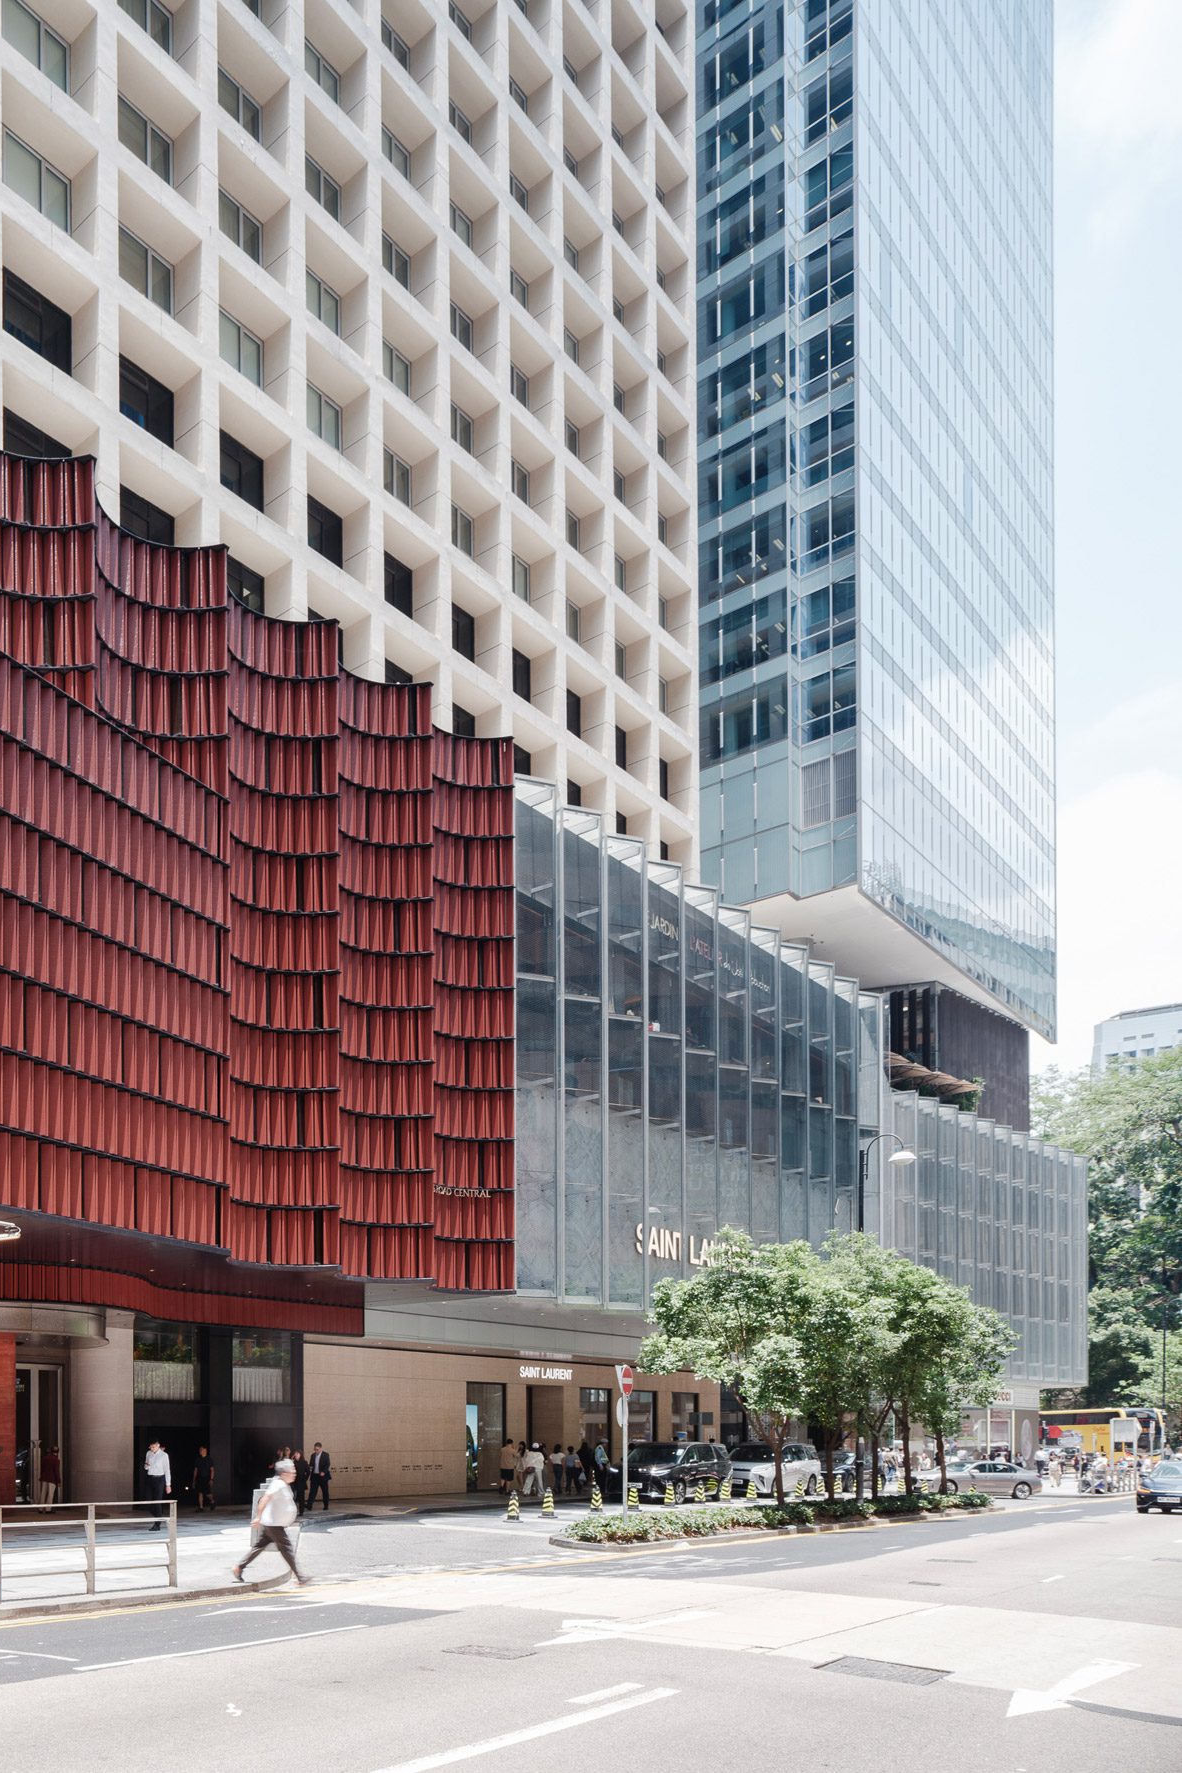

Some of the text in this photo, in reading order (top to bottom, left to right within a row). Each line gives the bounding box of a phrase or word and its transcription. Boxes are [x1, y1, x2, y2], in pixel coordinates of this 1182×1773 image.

[650, 912, 679, 940] JARDIN
[454, 1187, 491, 1198] CENTRAL
[519, 1366, 573, 1380] SAINT LAURENT
